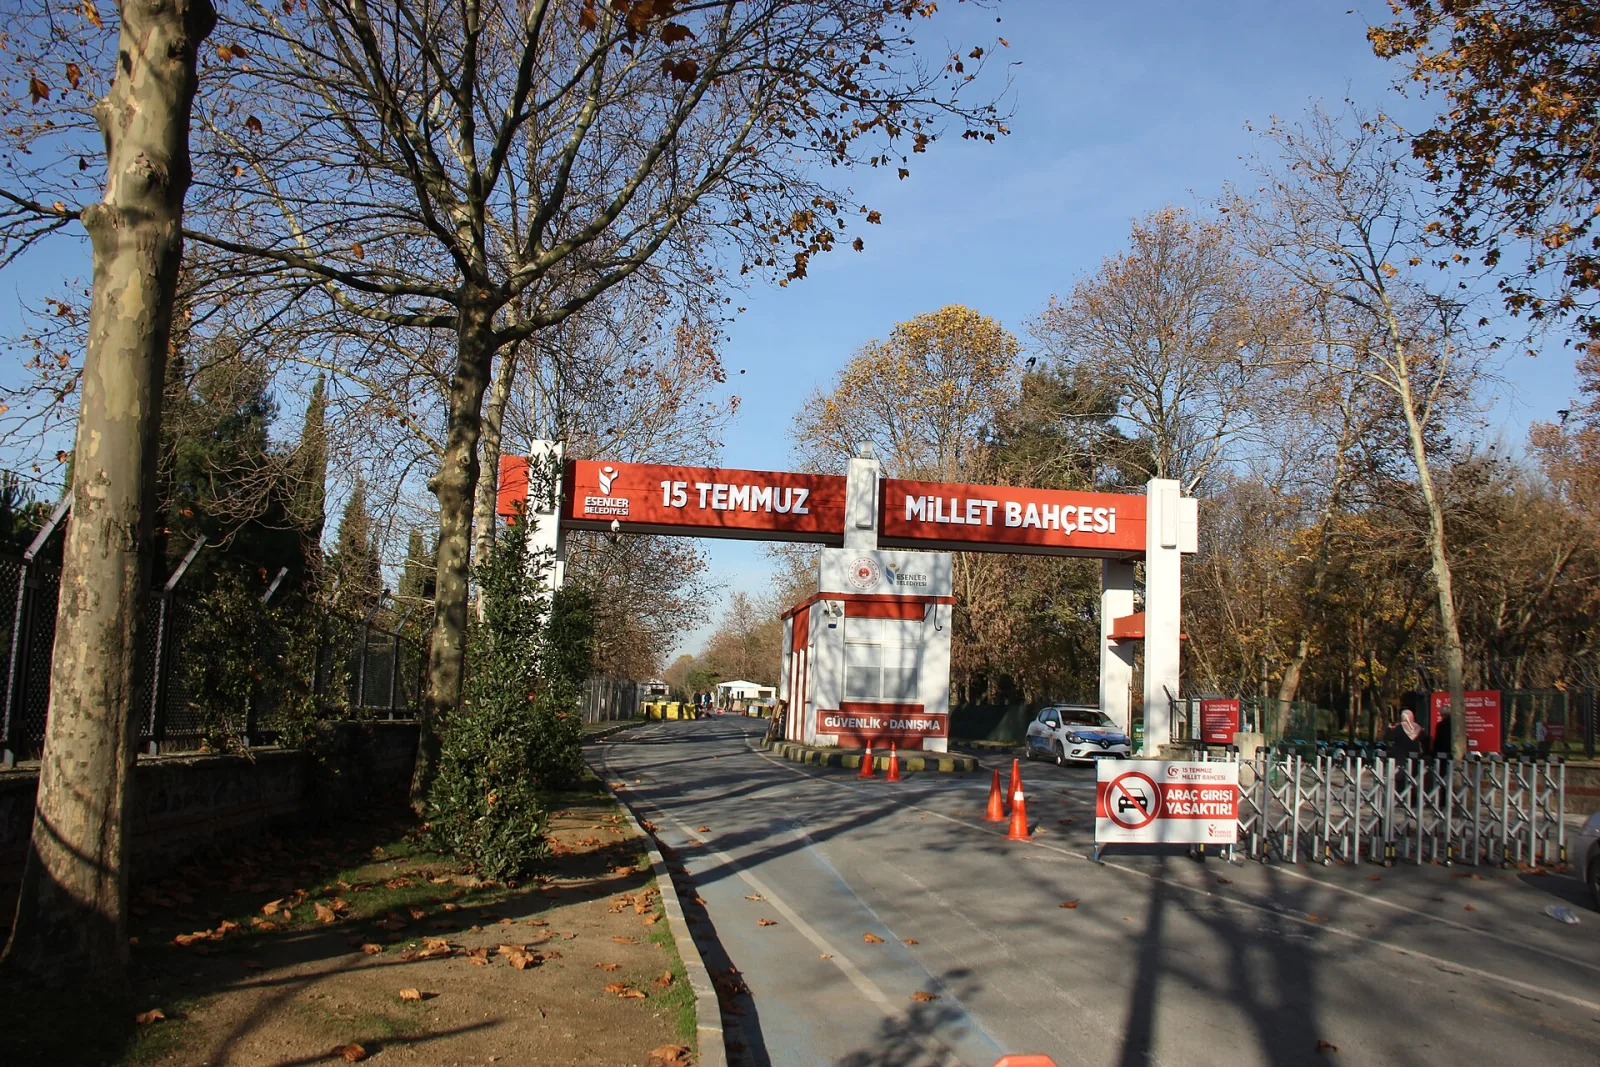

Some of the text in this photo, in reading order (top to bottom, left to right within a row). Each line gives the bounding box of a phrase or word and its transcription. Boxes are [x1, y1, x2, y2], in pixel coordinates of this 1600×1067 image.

[584, 496, 630, 508] ESENLER
[660, 480, 810, 515] 15 TEMMUZ
[896, 573, 927, 581] ESENLER
[824, 715, 941, 732] GÜVENLİK DANIŞMA
[1165, 789, 1198, 802] ARAÇ
[1165, 802, 1233, 815] YASAKTIR!
